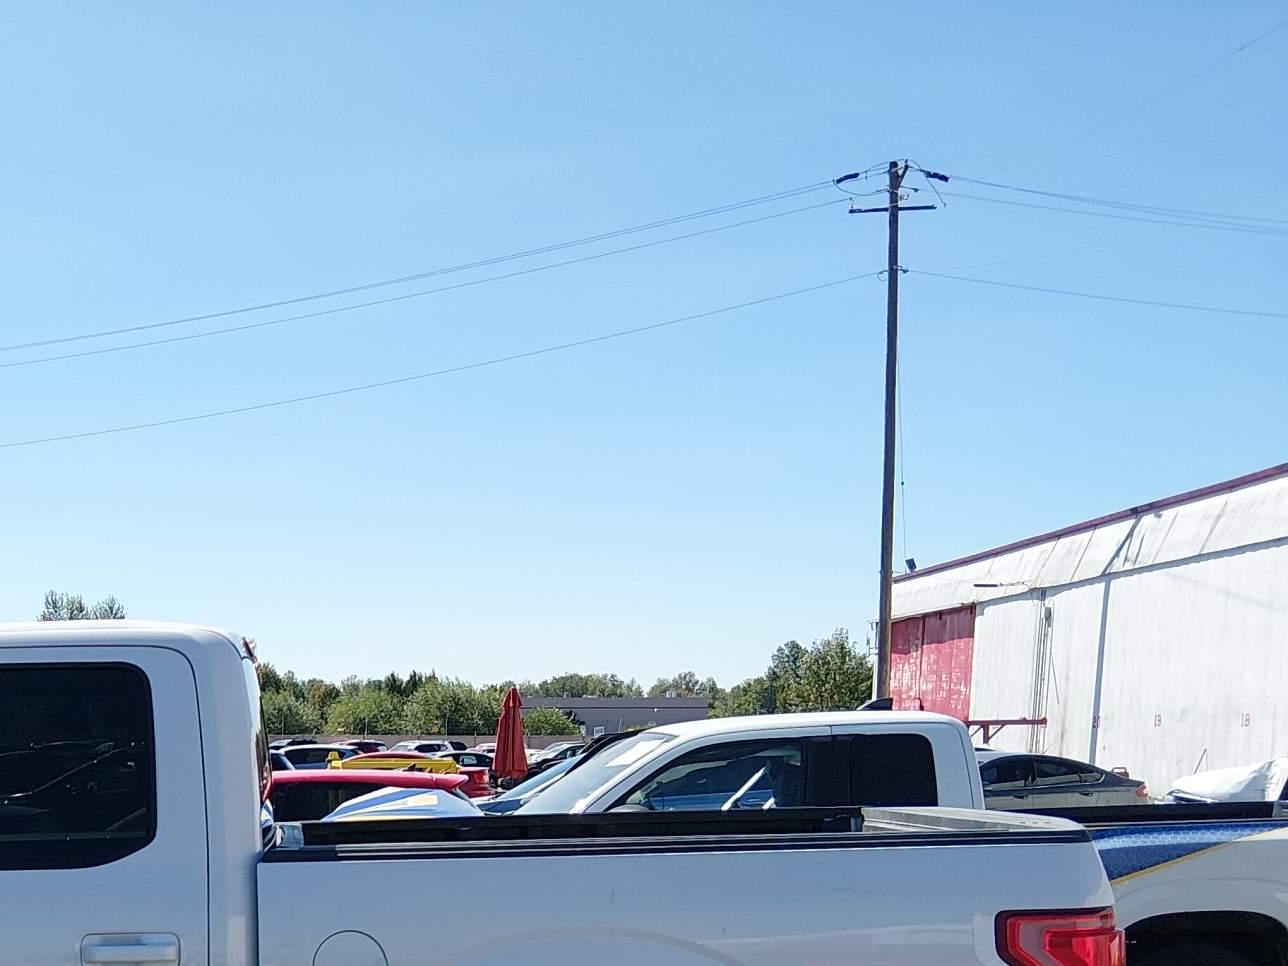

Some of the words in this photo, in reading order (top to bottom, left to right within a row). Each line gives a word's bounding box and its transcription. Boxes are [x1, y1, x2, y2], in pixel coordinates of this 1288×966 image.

[1092, 714, 1101, 729] 20
[1154, 713, 1162, 728] 19
[1240, 713, 1251, 728] 18
